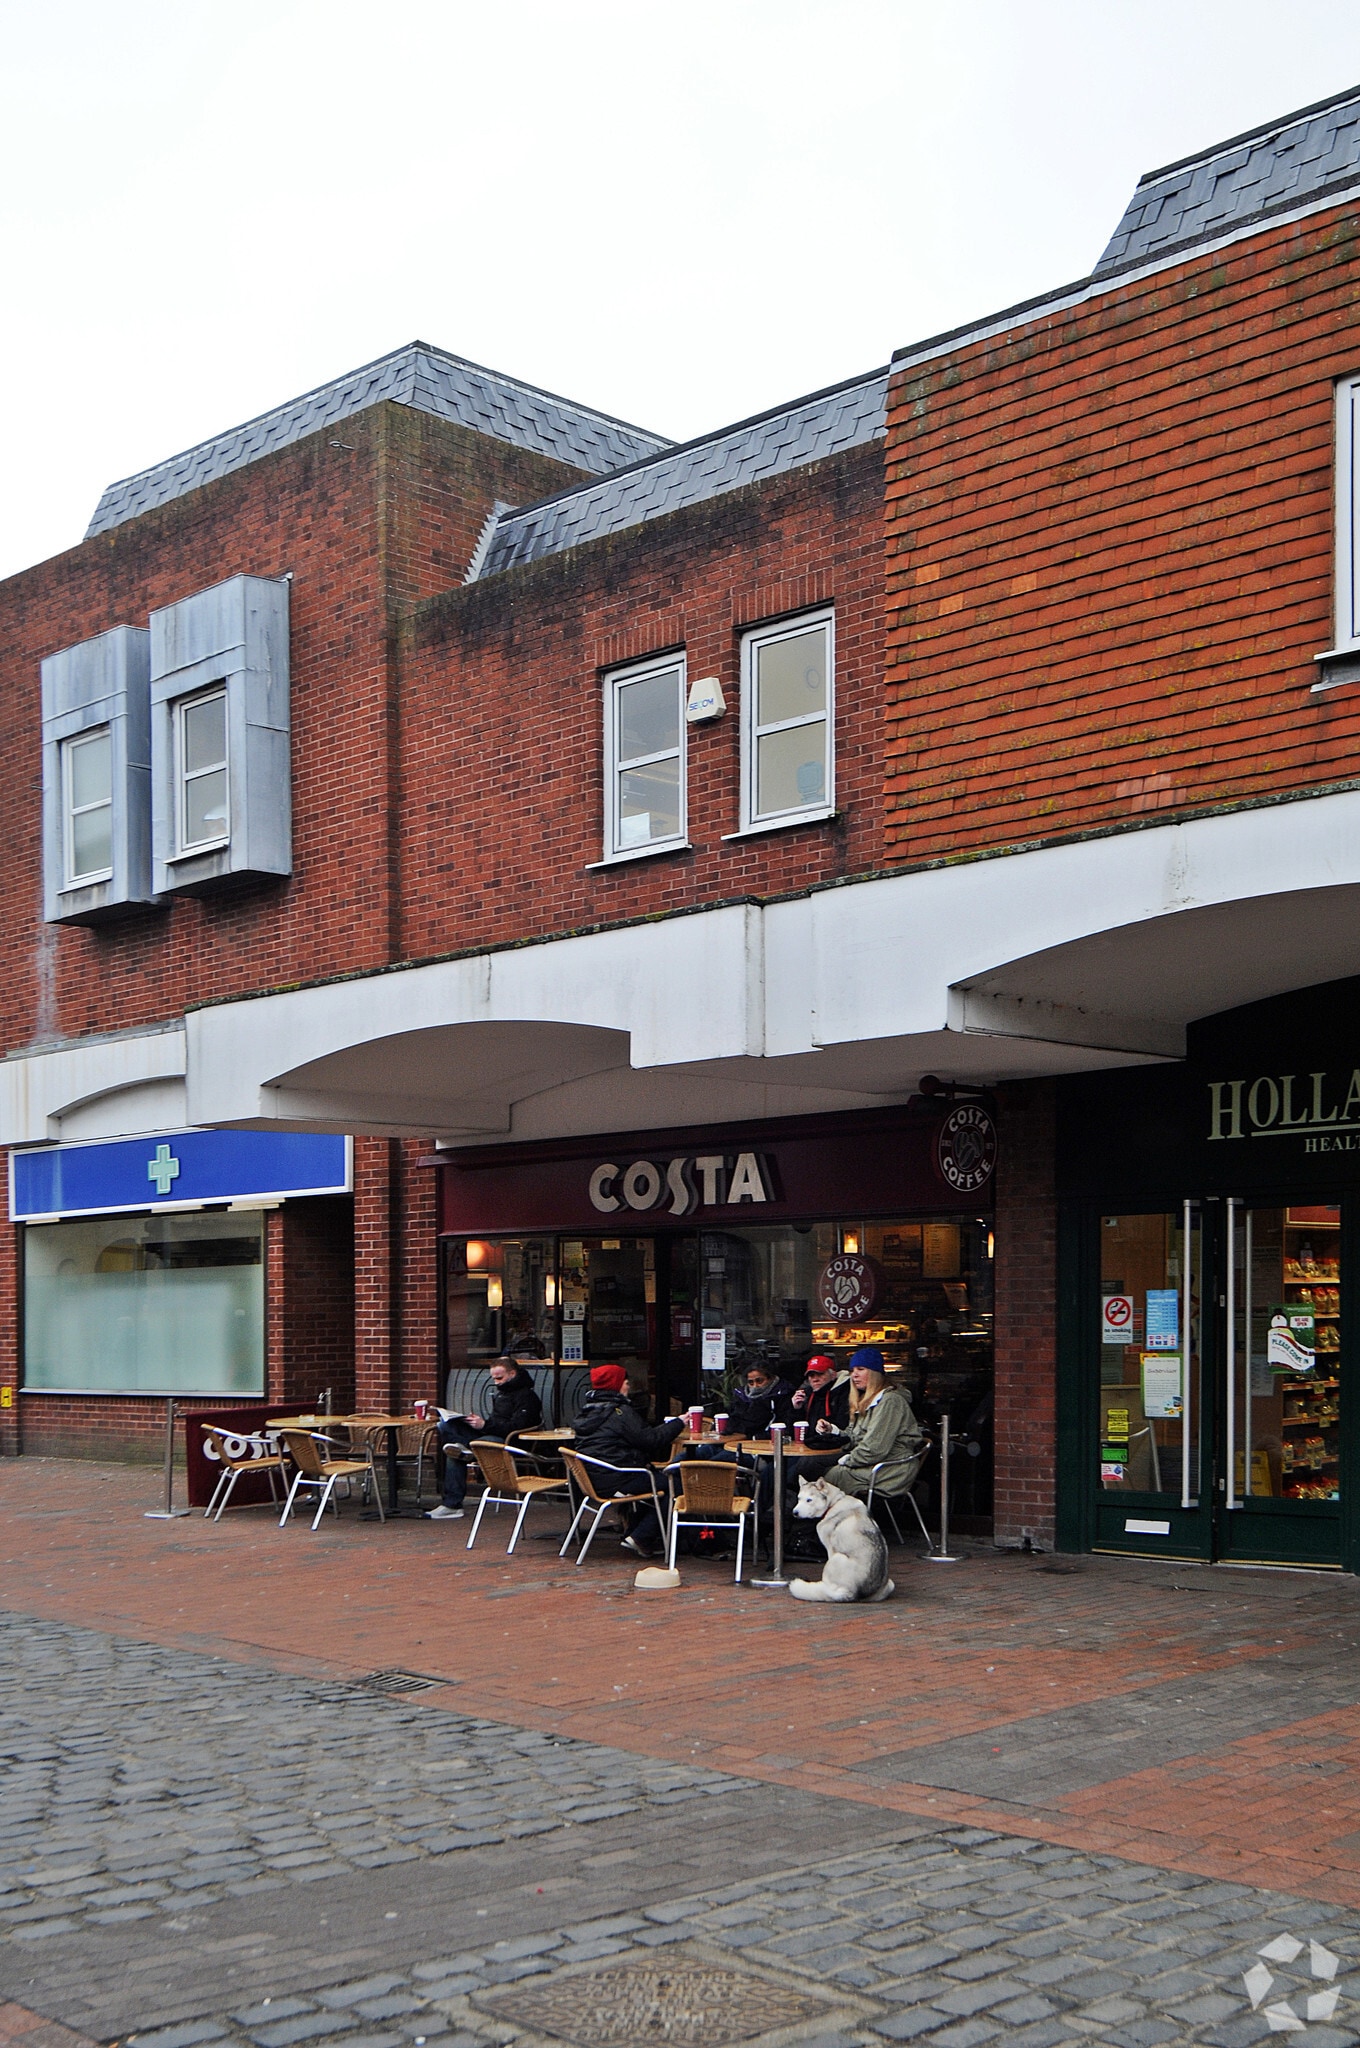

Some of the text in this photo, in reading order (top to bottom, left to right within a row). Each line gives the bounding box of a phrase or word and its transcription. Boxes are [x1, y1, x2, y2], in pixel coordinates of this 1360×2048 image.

[689, 698, 714, 711] SECOM
[1207, 1068, 1360, 1141] HOLLA
[948, 1108, 990, 1135] COSTA
[588, 1151, 770, 1216] COSTA
[943, 1156, 991, 1188] COFFEE
[826, 1258, 865, 1279] COSTA
[823, 1294, 870, 1319] COFFEE
[1271, 1338, 1290, 1351] PLEASE
[1289, 1349, 1303, 1363] COME
[202, 1429, 292, 1461] COST
